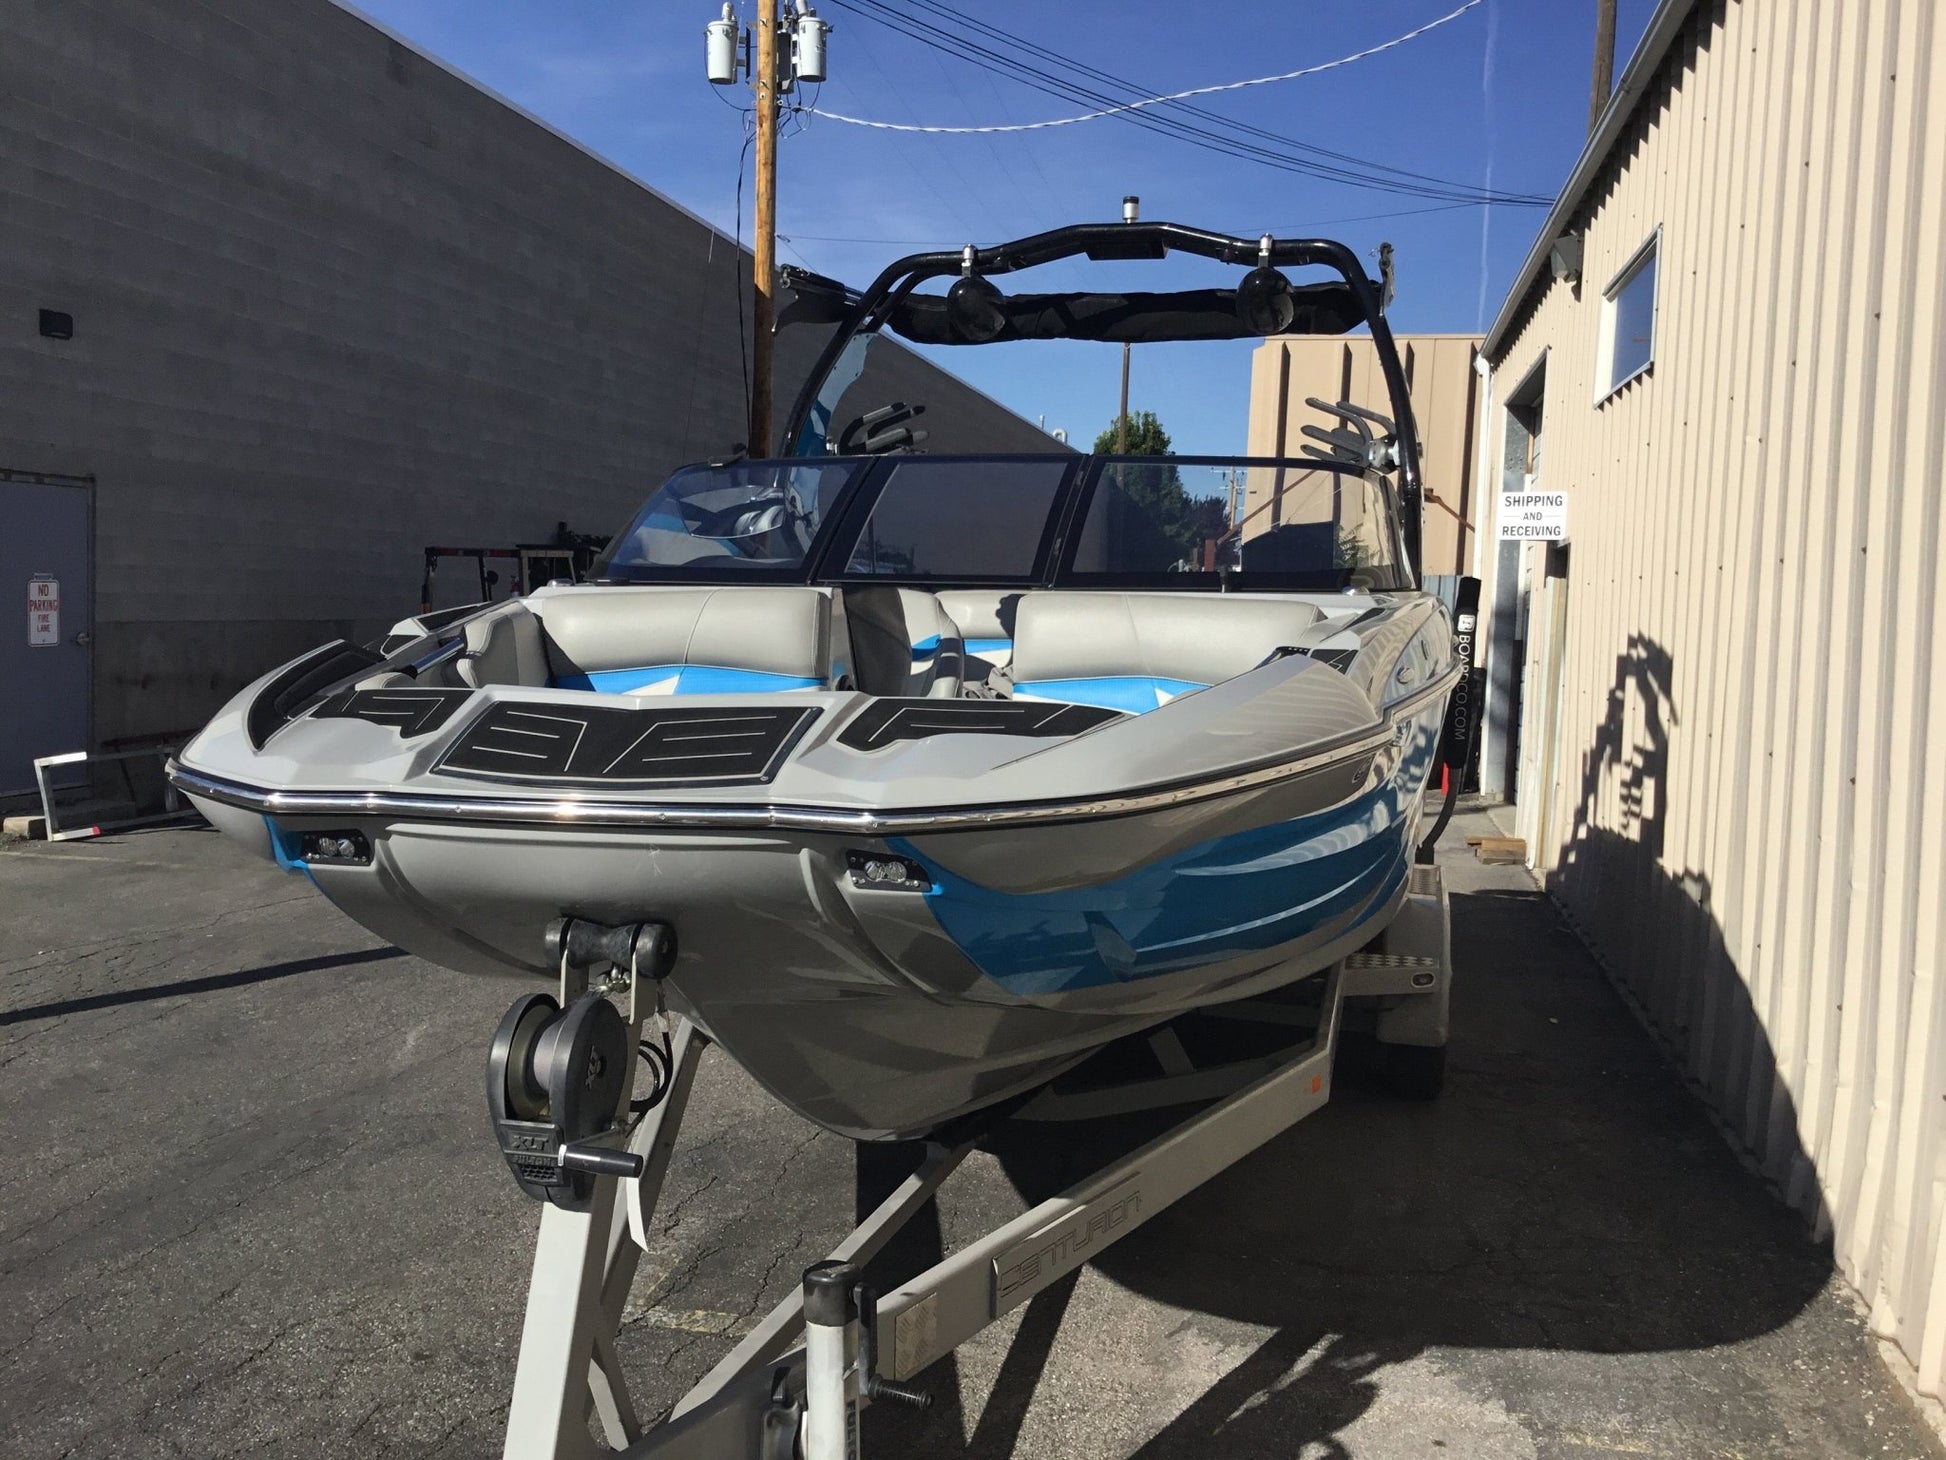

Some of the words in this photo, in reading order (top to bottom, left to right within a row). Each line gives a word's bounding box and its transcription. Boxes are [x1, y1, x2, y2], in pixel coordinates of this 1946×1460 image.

[1505, 495, 1562, 507] SHIPPING
[1523, 512, 1543, 521] AND
[1502, 525, 1561, 536] RECEIVING
[38, 584, 49, 596] NO
[29, 600, 58, 612] PARKING
[513, 1135, 549, 1150] XLT
